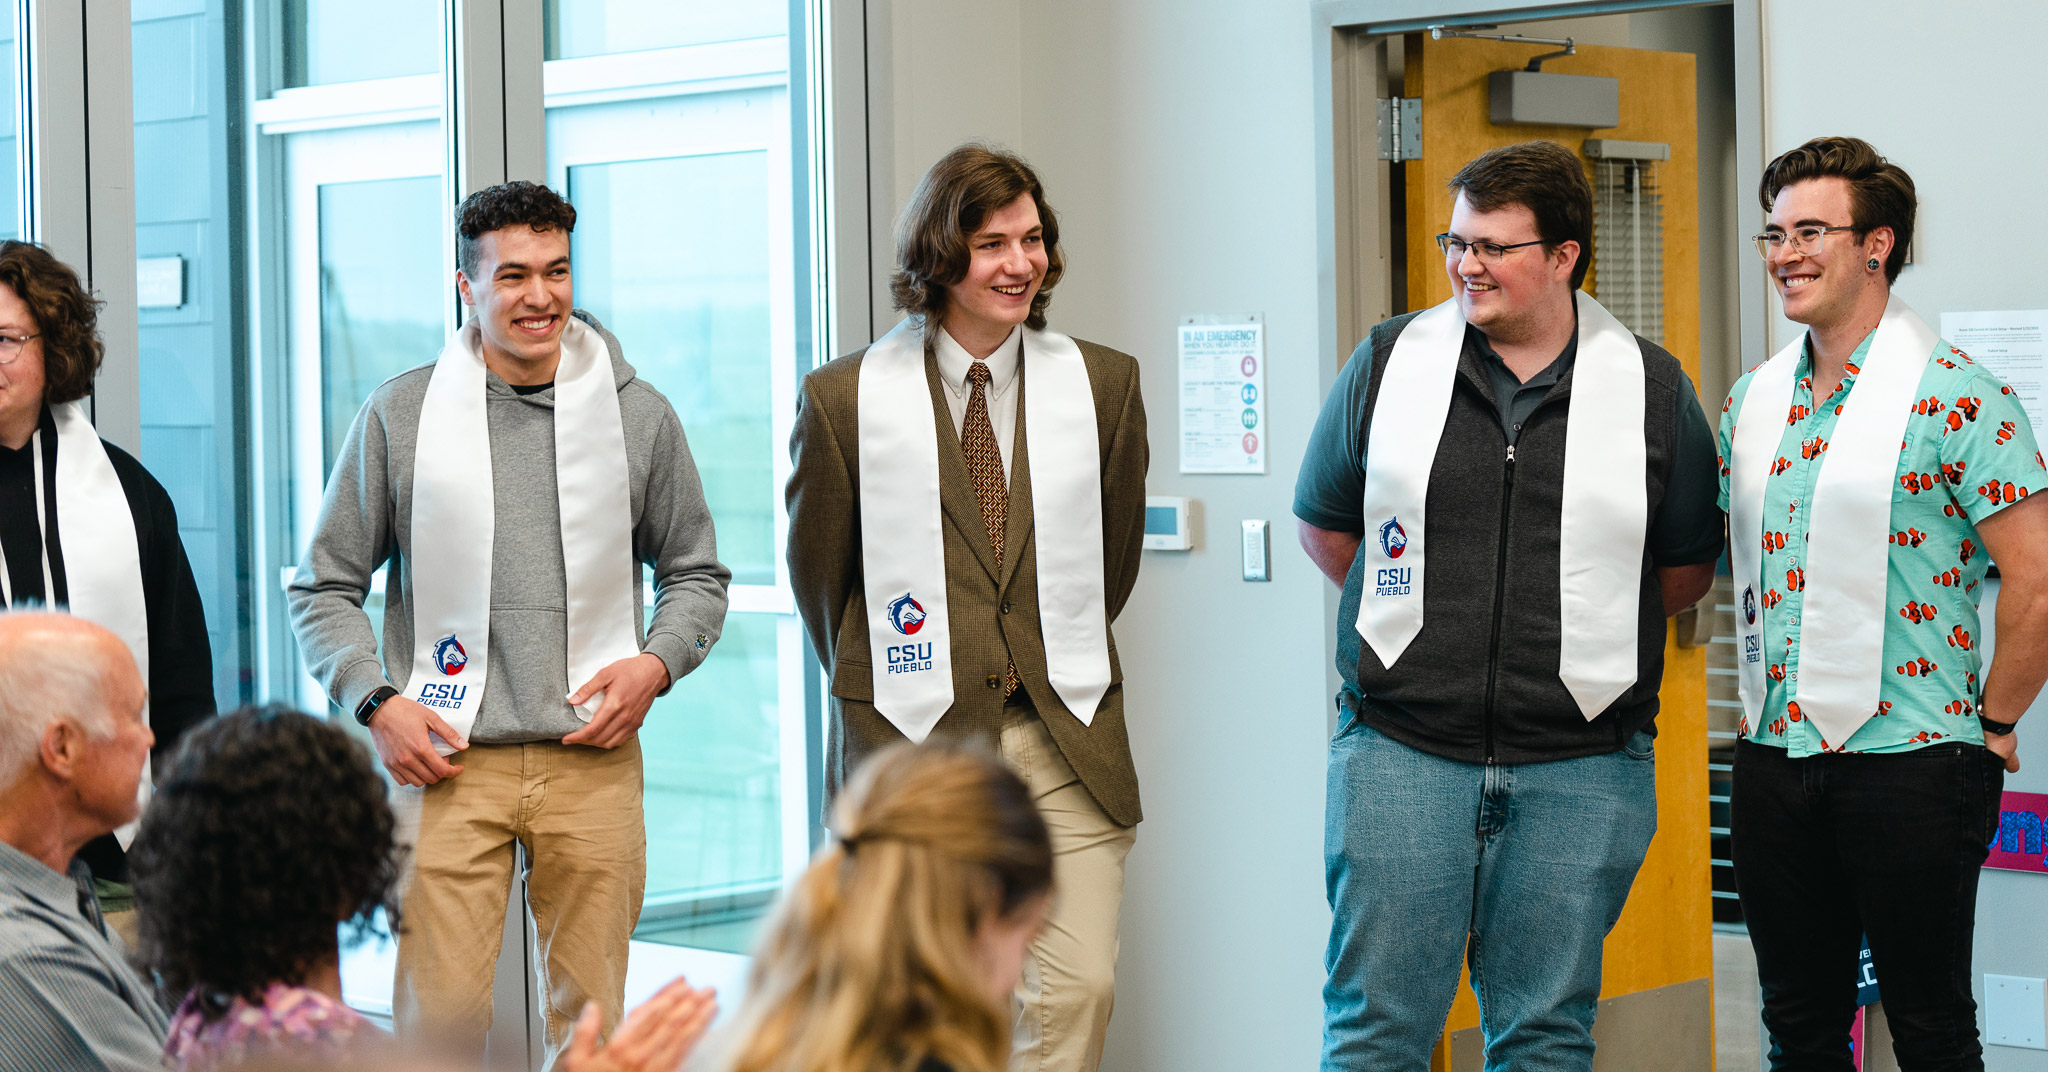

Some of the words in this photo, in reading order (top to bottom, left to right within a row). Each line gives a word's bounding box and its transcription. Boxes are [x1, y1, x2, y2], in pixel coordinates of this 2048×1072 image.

[1207, 330, 1257, 341] EMERGENCY
[1377, 567, 1412, 586] CSU
[1375, 585, 1411, 597] PUEBLO
[1745, 633, 1760, 653] CSU
[887, 641, 932, 664] CSU
[888, 660, 932, 675] PUEBLO
[420, 683, 467, 701] CSU
[416, 697, 462, 709] PUEBLO
